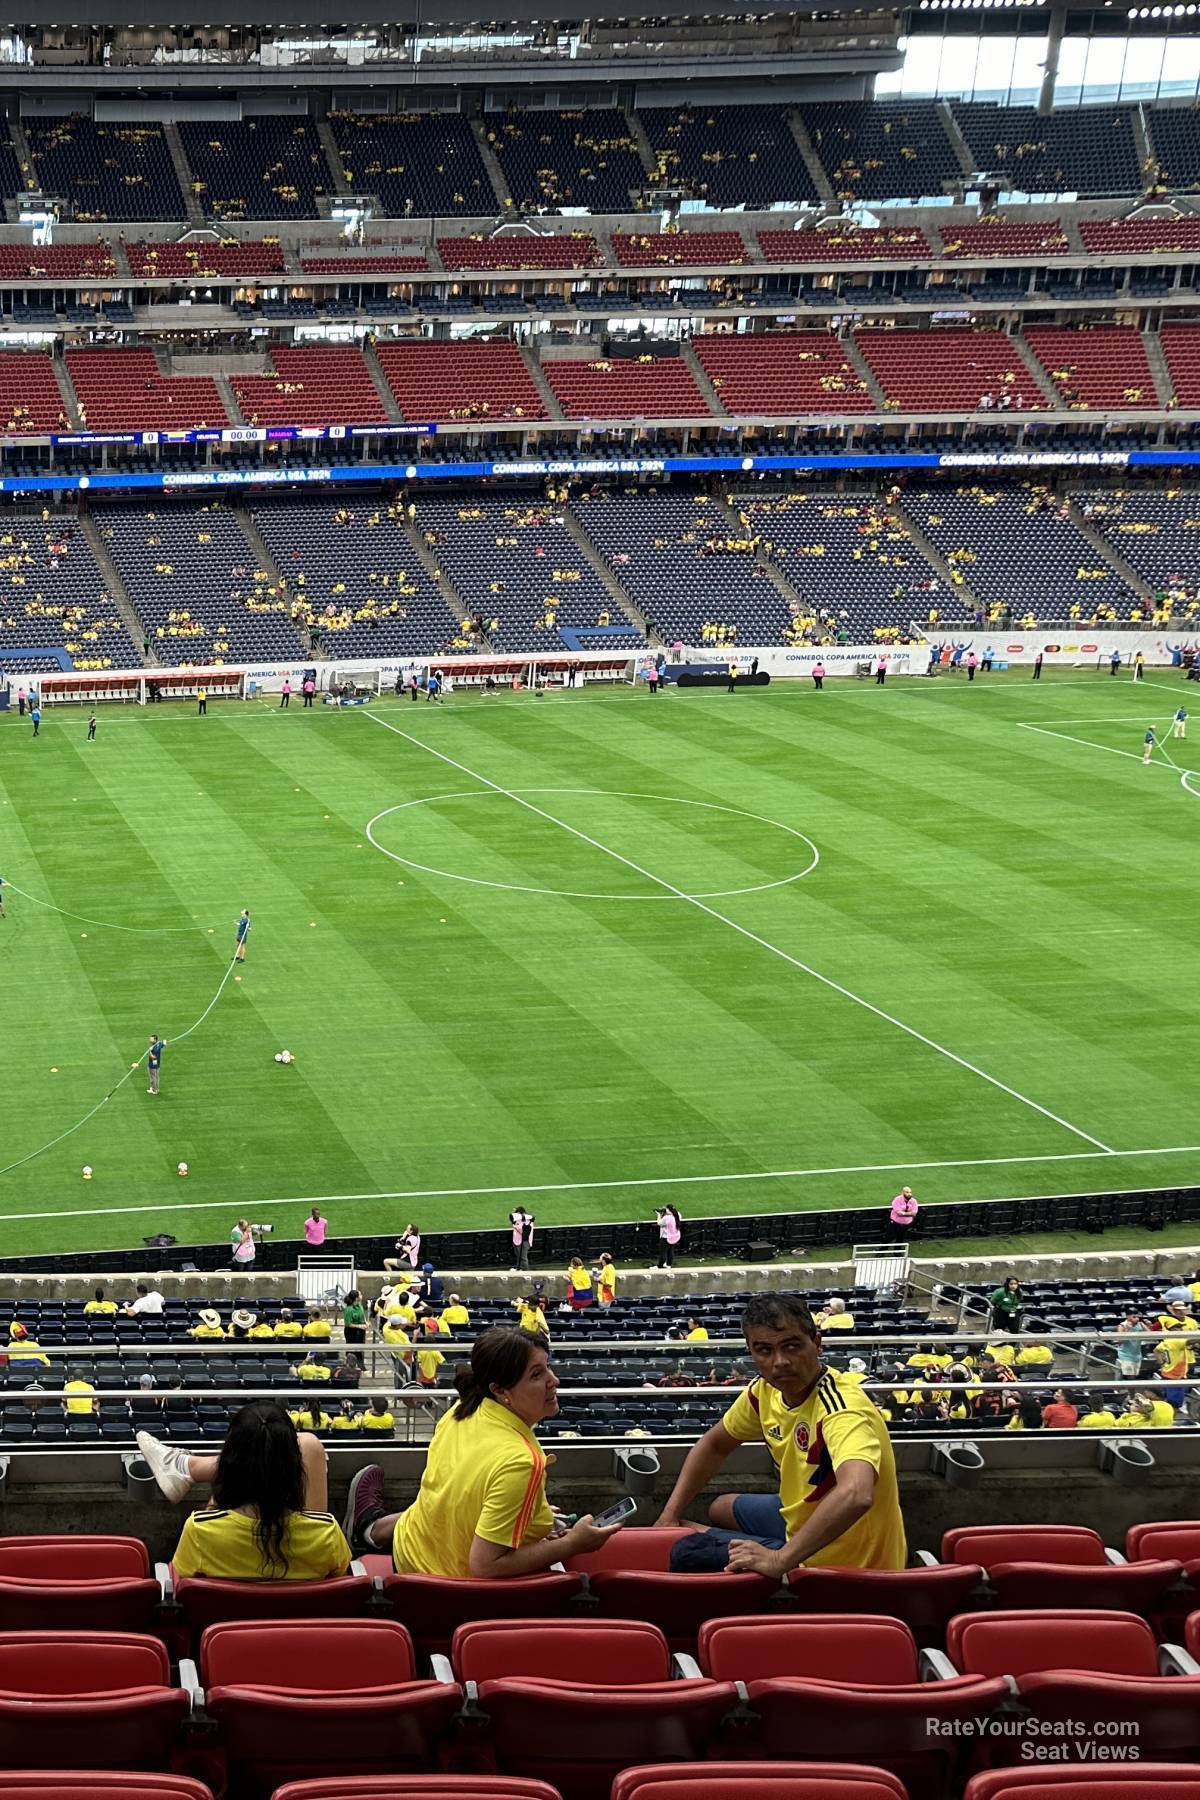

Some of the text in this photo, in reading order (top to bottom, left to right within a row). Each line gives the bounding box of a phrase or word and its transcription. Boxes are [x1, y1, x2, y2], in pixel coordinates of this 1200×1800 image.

[939, 452, 1130, 466] CONMEBOL COPA AMERICA USA 2024
[492, 460, 665, 474] CONMEBOL COPA AMERICA USA 2024
[162, 469, 331, 485] CONMEBOL COPA AMERICA USA 2024
[786, 653, 825, 661] CONMEBOL
